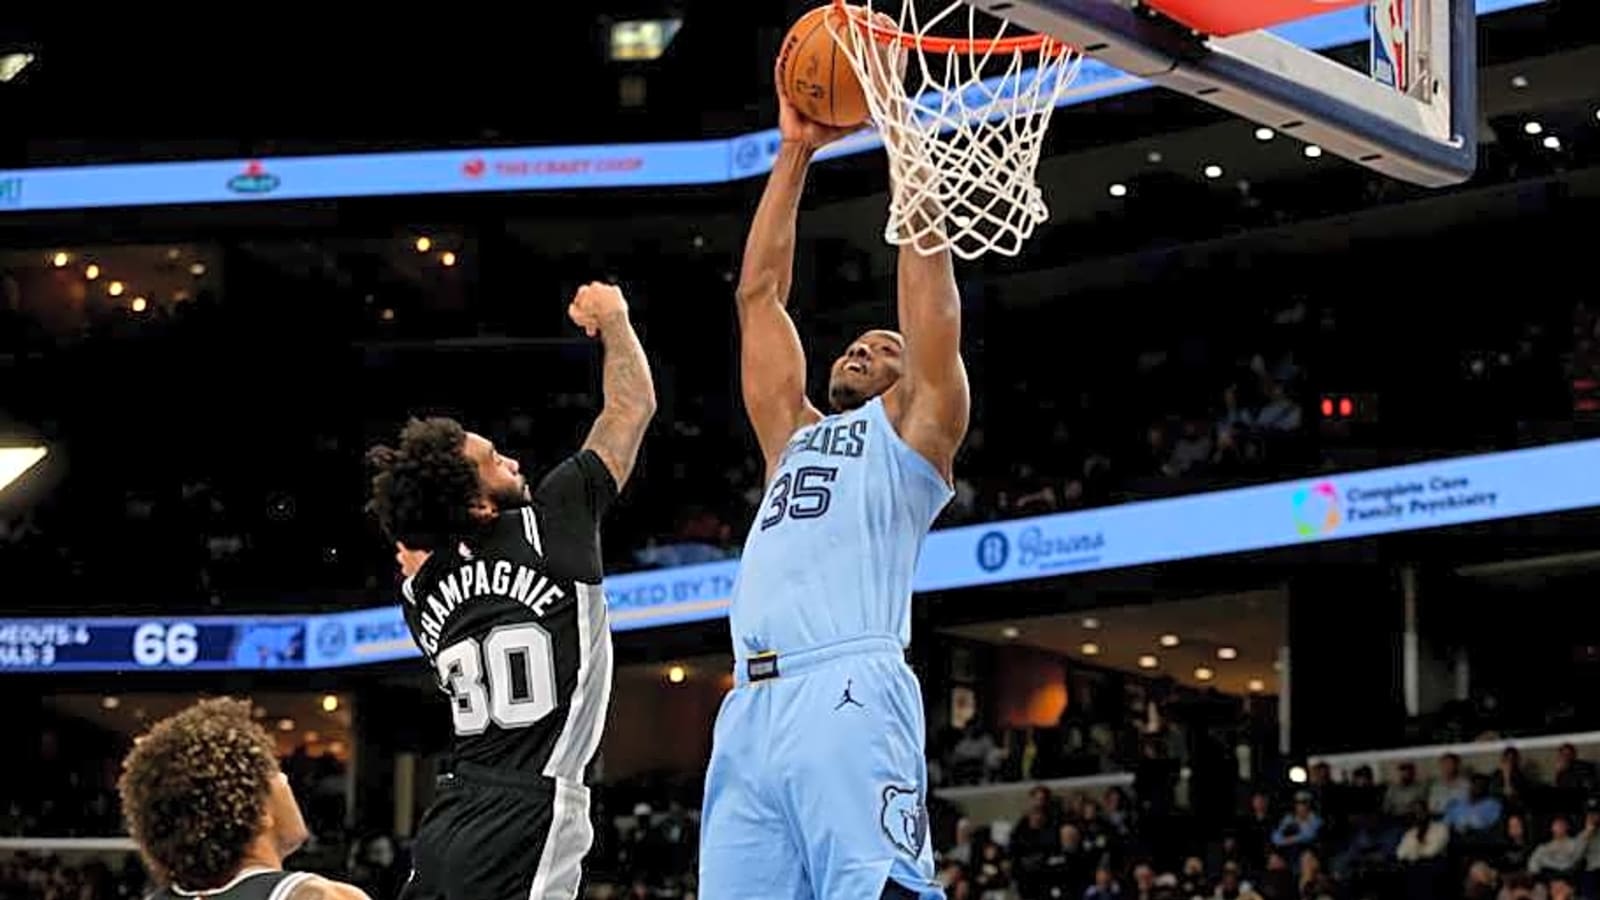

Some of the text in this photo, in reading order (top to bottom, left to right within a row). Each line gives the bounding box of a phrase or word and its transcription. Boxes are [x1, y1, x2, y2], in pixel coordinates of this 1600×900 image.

[761, 466, 839, 531] 35
[132, 622, 199, 666] 66
[419, 559, 565, 656] CHAMPAGNIE
[434, 621, 558, 737] 30
